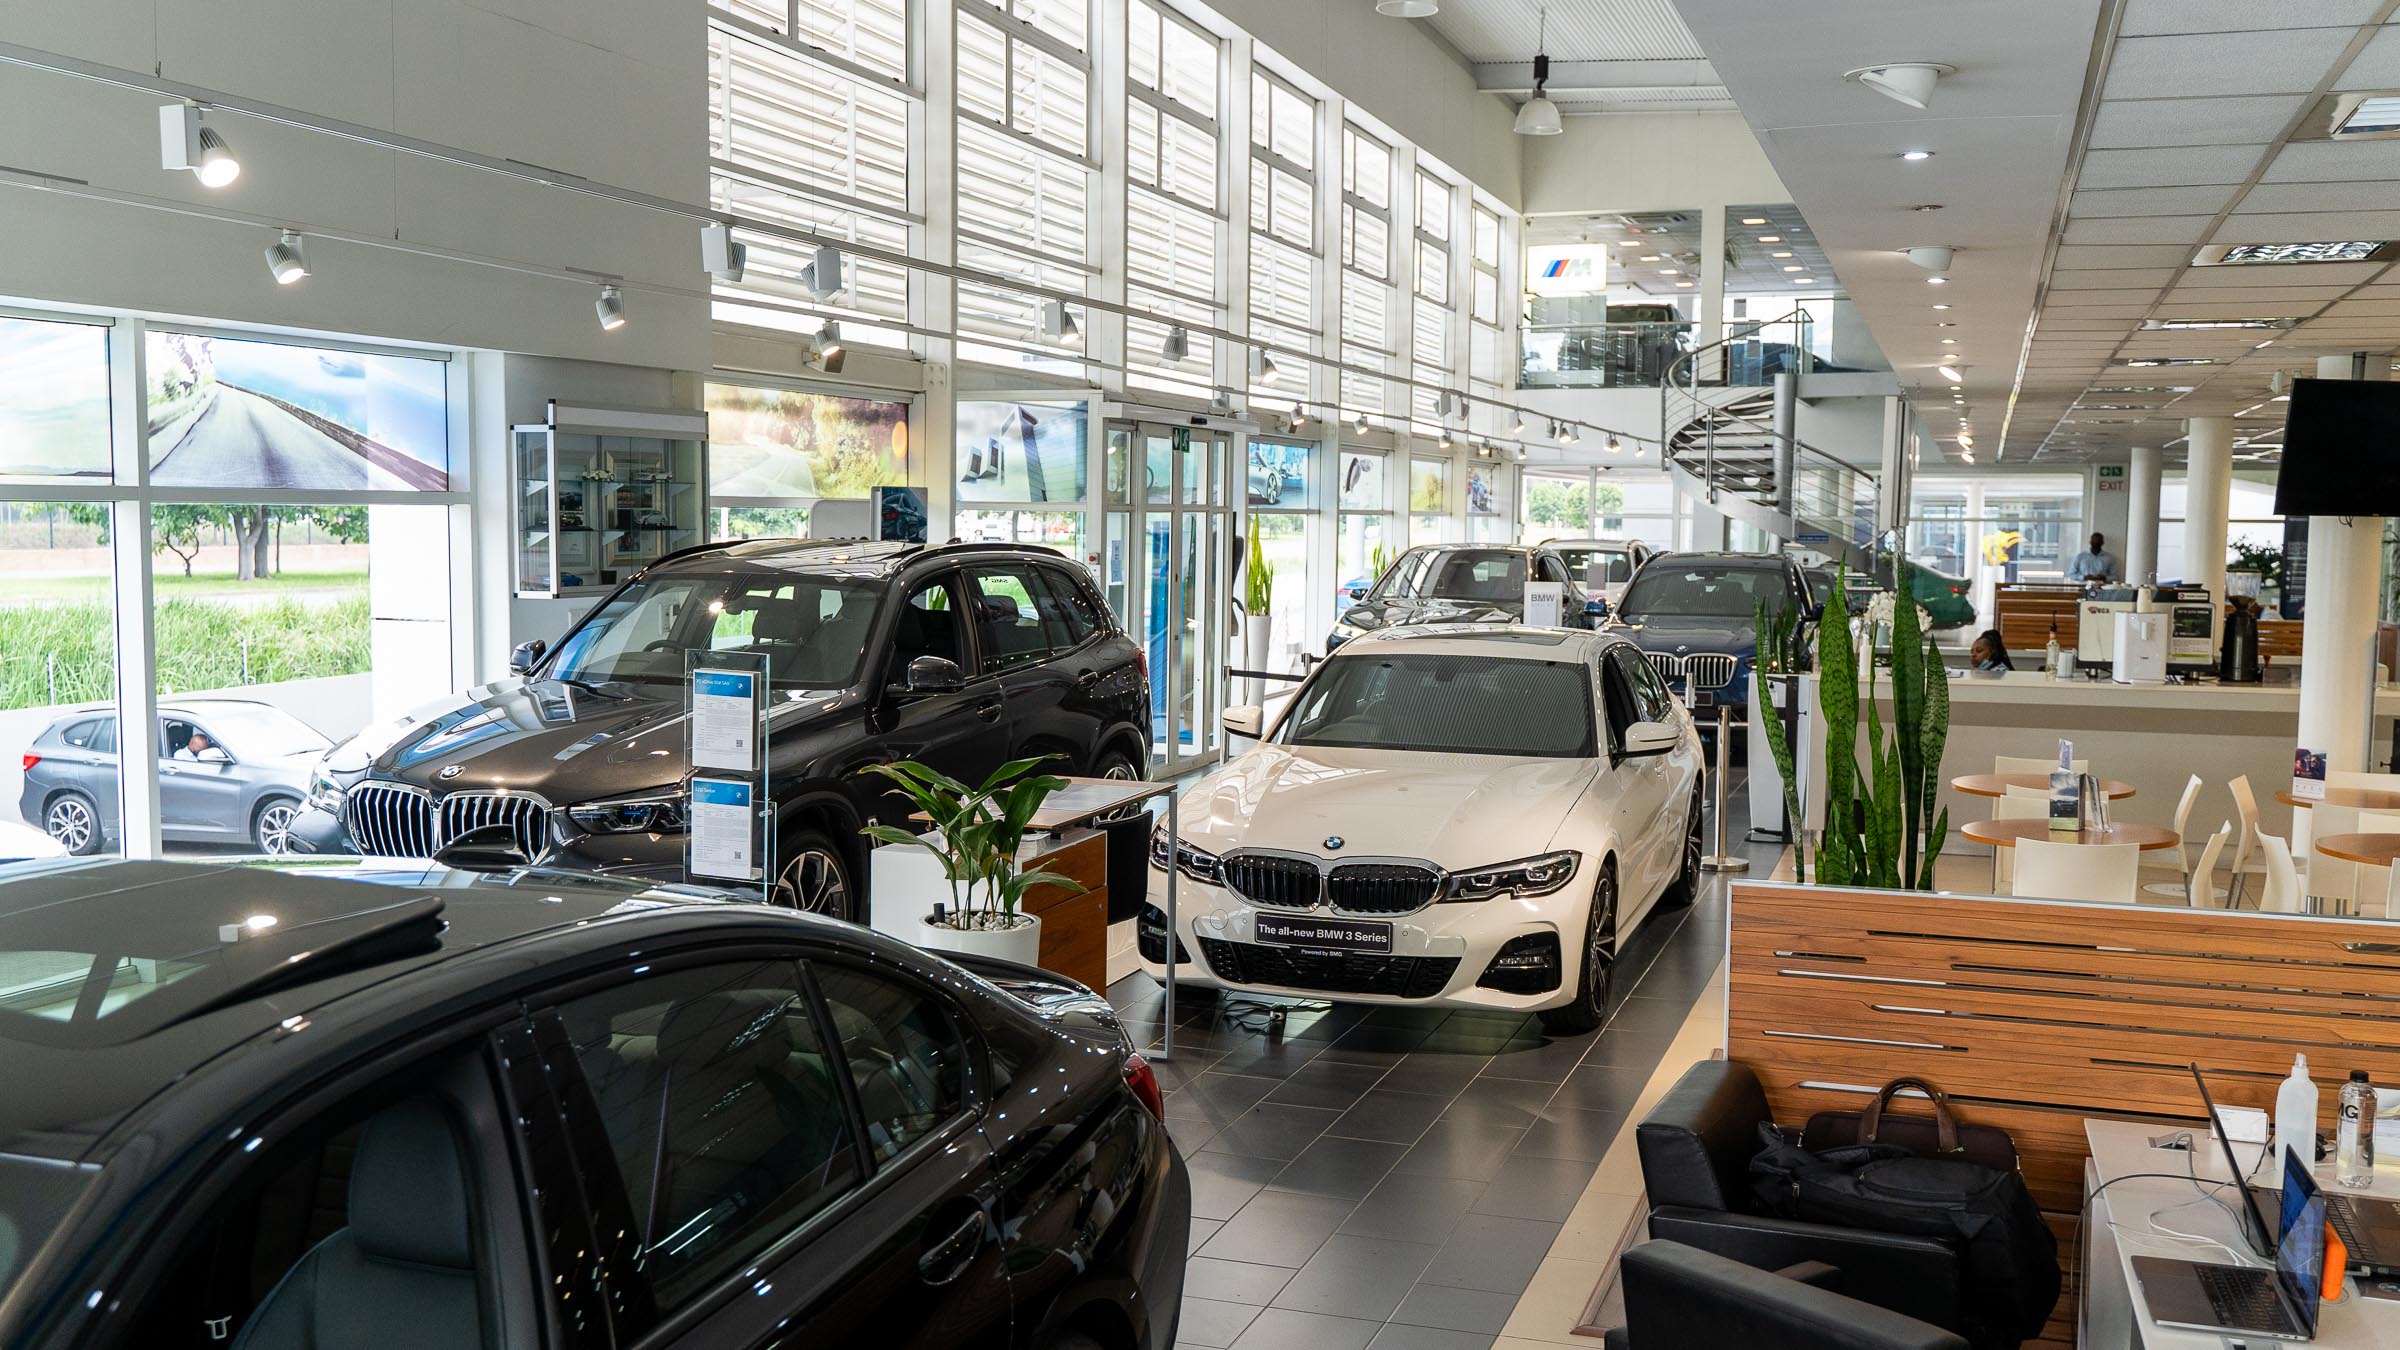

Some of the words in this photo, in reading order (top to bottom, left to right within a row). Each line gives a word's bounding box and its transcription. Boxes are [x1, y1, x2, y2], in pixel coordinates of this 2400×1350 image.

[2099, 480, 2124, 491] EXIT
[1531, 593, 1555, 602] BMW
[1258, 923, 1277, 935] The
[1278, 926, 1315, 938] all-new
[1316, 928, 1344, 940] BMW
[1345, 931, 1353, 941] 3
[1354, 931, 1388, 943] Series
